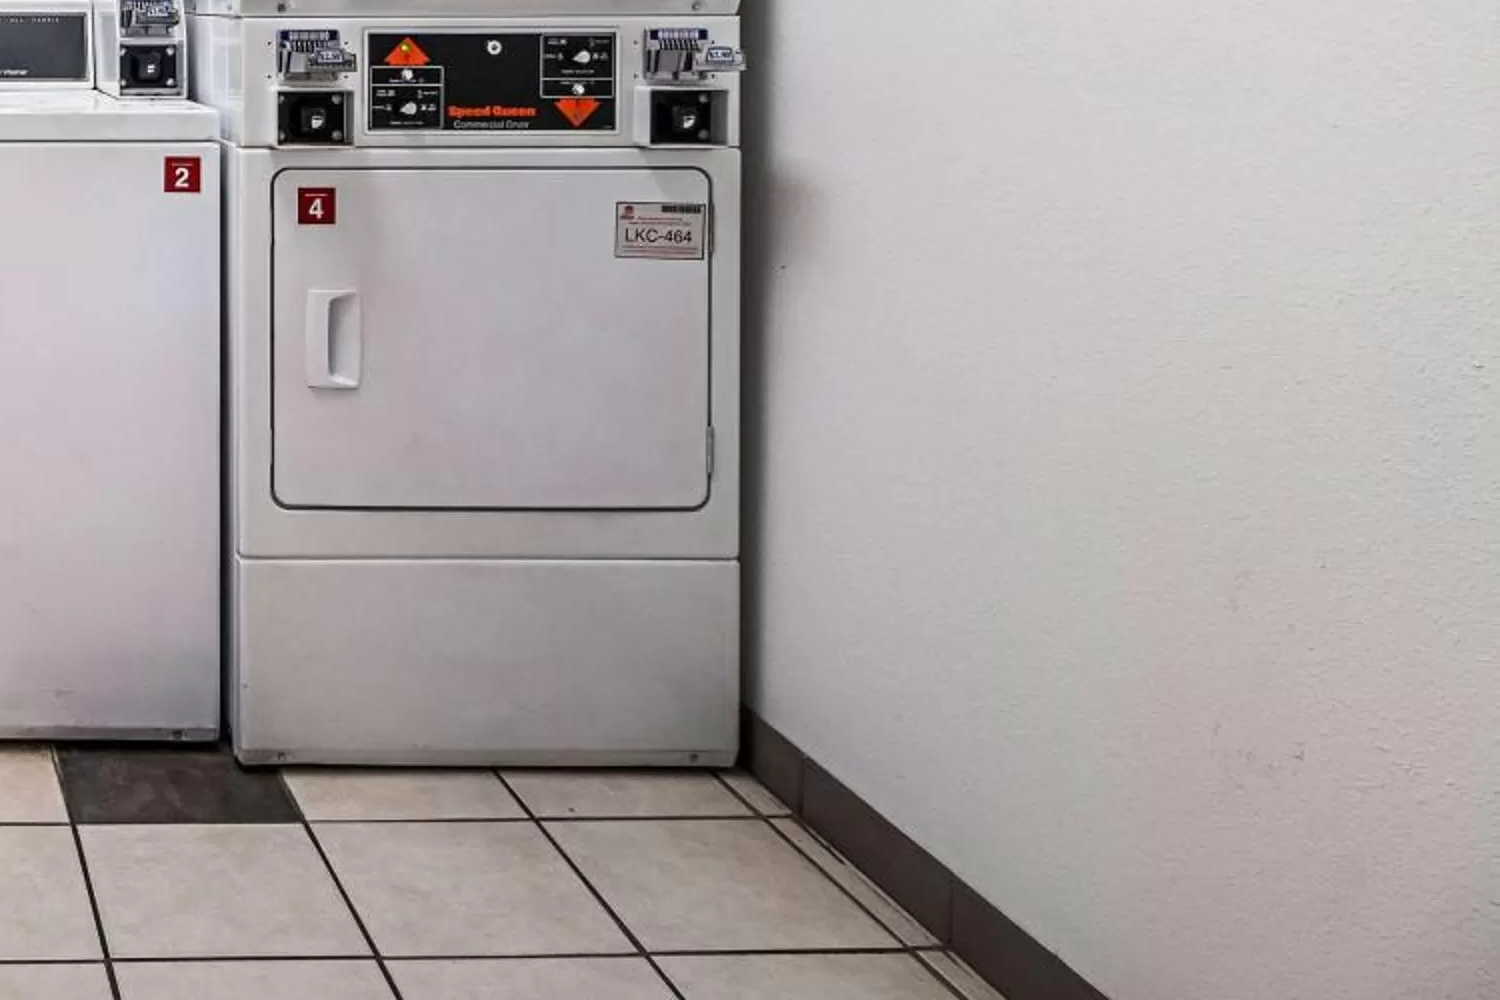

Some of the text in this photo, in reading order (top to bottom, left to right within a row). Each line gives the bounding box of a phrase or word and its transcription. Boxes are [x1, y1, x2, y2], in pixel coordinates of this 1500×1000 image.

[448, 105, 536, 119] Speed Queen
[175, 167, 189, 187] 2
[308, 198, 324, 219] 4
[625, 228, 692, 243] LKC-464
